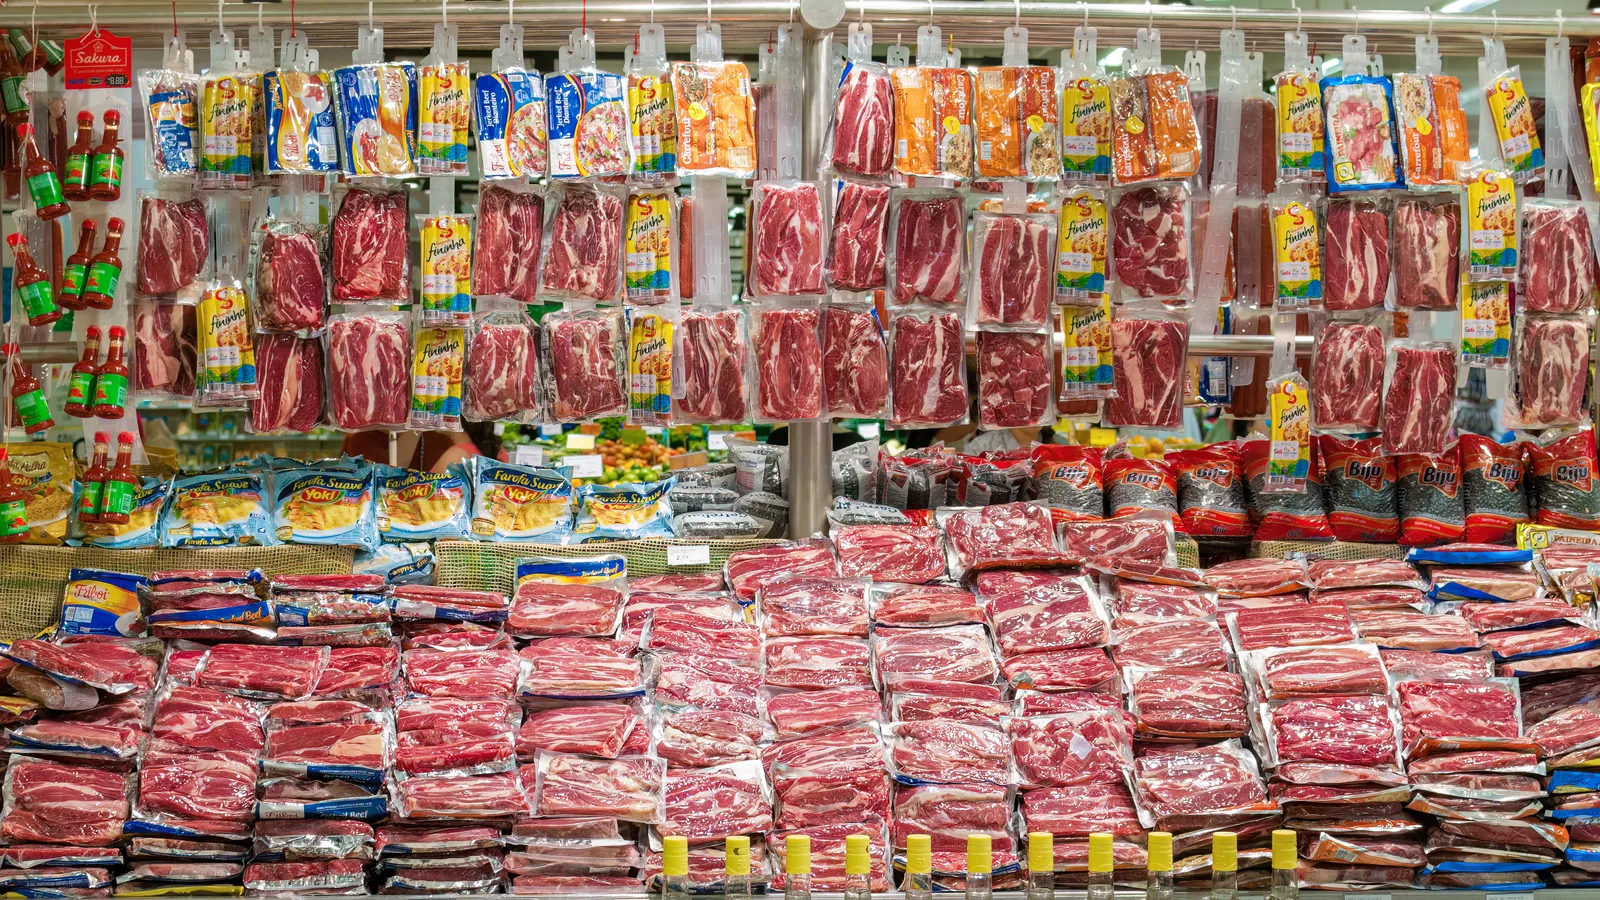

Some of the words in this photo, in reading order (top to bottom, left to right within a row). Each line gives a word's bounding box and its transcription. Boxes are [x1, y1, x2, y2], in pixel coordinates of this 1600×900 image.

[75, 51, 121, 64] Sakura
[426, 89, 464, 111] fininha
[482, 90, 490, 104] Beef
[554, 86, 562, 104] Beef
[956, 74, 967, 120] Carrefour
[1040, 71, 1050, 120] Carrefour
[208, 99, 247, 123] fininha
[484, 106, 495, 128] Jerked
[491, 92, 500, 124] Dianteiro
[556, 105, 565, 127] Jerked
[562, 92, 571, 124] Dianteiro
[632, 98, 668, 124] fininha
[1070, 100, 1106, 124] fininha
[1286, 96, 1318, 120] fininha
[1503, 96, 1526, 128] fininha
[682, 116, 692, 165] Carrefour
[1120, 133, 1132, 177] Carrefour
[1412, 132, 1420, 180] Carrefour
[1476, 192, 1511, 218] fininha
[628, 214, 664, 240] fininha
[1065, 217, 1104, 239] fininha
[1283, 225, 1314, 250] fininha
[427, 238, 466, 262] fininha
[1469, 284, 1504, 306] fininha
[209, 308, 246, 336] fininha
[1069, 309, 1106, 335] fininha
[420, 340, 460, 363] fininha
[633, 336, 666, 362] fininha
[1278, 404, 1308, 428] fininha
[21, 460, 48, 472] Palha
[1054, 464, 1088, 482] Biju
[1195, 466, 1230, 480] Biju
[1348, 460, 1382, 480] Biju
[1423, 467, 1456, 486] Biju
[1488, 462, 1520, 482] Biju
[1556, 466, 1588, 482] Biju
[214, 481, 248, 491] Suave
[293, 474, 326, 492] Farofa
[327, 478, 363, 490] Suave
[386, 476, 418, 488] Farofa
[494, 470, 530, 486] Farofa
[1126, 472, 1160, 485] Biju
[306, 490, 336, 501] Yoki
[402, 486, 429, 498] Yoki
[508, 489, 542, 504] Yoki
[594, 494, 628, 502] Farofa
[630, 490, 662, 504] Suave
[1553, 536, 1598, 545] PAINEIRA
[74, 584, 108, 600] Friboi
[245, 608, 263, 620] Beef
